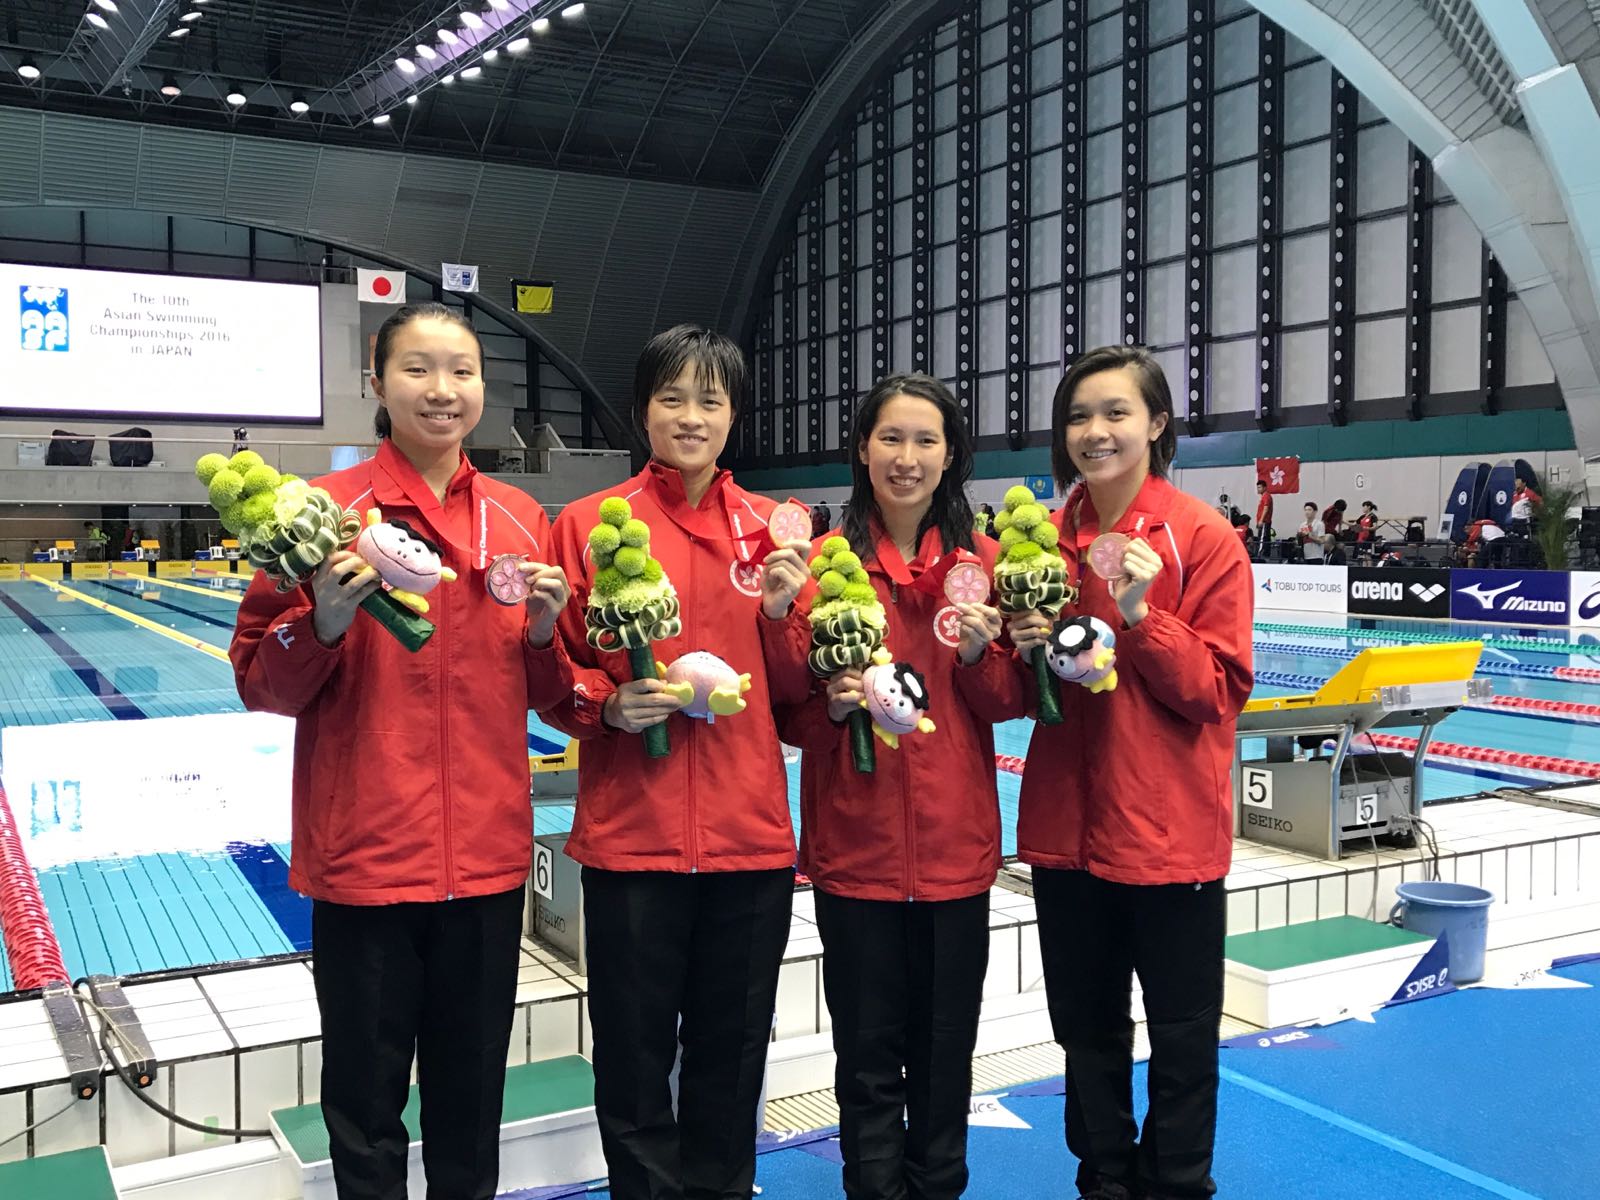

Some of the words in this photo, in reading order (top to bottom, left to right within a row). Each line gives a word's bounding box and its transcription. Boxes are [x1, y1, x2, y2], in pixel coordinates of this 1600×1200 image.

[132, 292, 155, 305] The
[163, 294, 190, 307] 10th
[103, 307, 141, 321] Asian
[146, 310, 217, 327] Swimming
[89, 323, 194, 342] Championships
[200, 330, 231, 342] 2016
[151, 344, 192, 357] JAPAN
[1355, 474, 1364, 489] G
[1549, 466, 1560, 482] H
[1274, 581, 1296, 592] TOBU
[1298, 582, 1313, 593] TOP
[1315, 582, 1342, 594] TOURS
[1351, 580, 1403, 601] arena
[1247, 771, 1267, 803] 5
[1359, 796, 1374, 822] 5
[1247, 812, 1293, 833] SEIKO
[536, 850, 548, 892] 6
[538, 903, 566, 934] SEIKO
